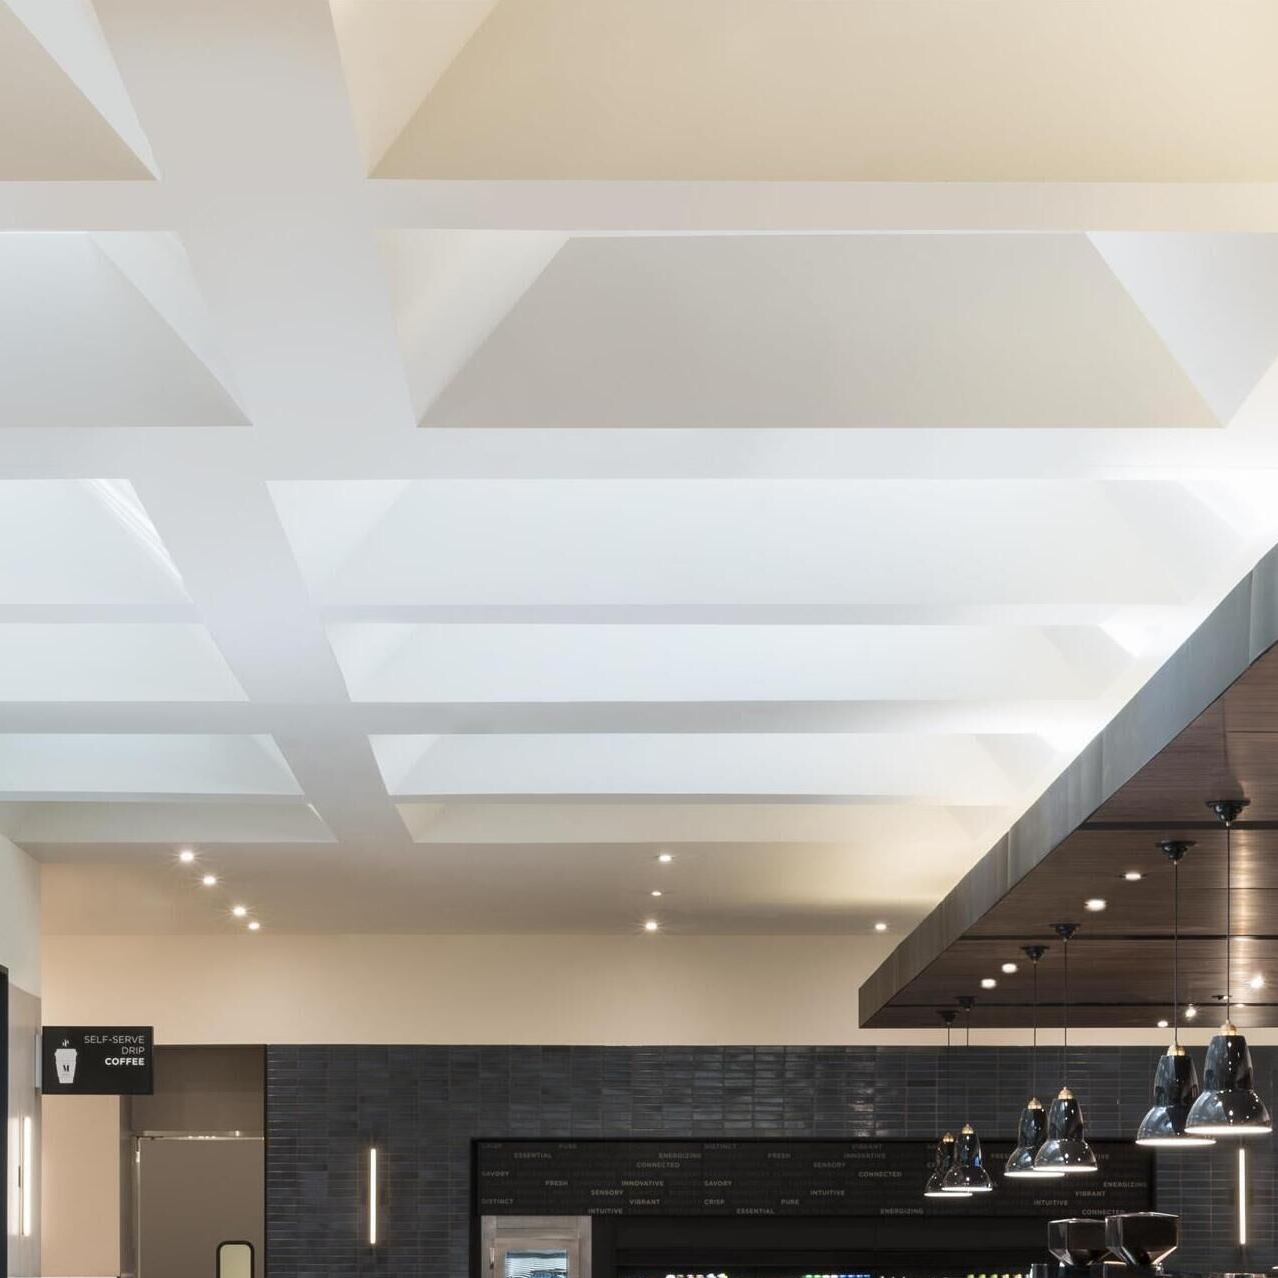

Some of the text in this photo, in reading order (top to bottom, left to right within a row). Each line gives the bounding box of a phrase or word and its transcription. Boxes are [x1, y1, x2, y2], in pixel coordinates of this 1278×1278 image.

[84, 1035, 145, 1044] SELF-SERVE
[121, 1046, 145, 1055] DRIP
[104, 1057, 145, 1066] COFFEE
[810, 1189, 846, 1197] INTUITIVE
